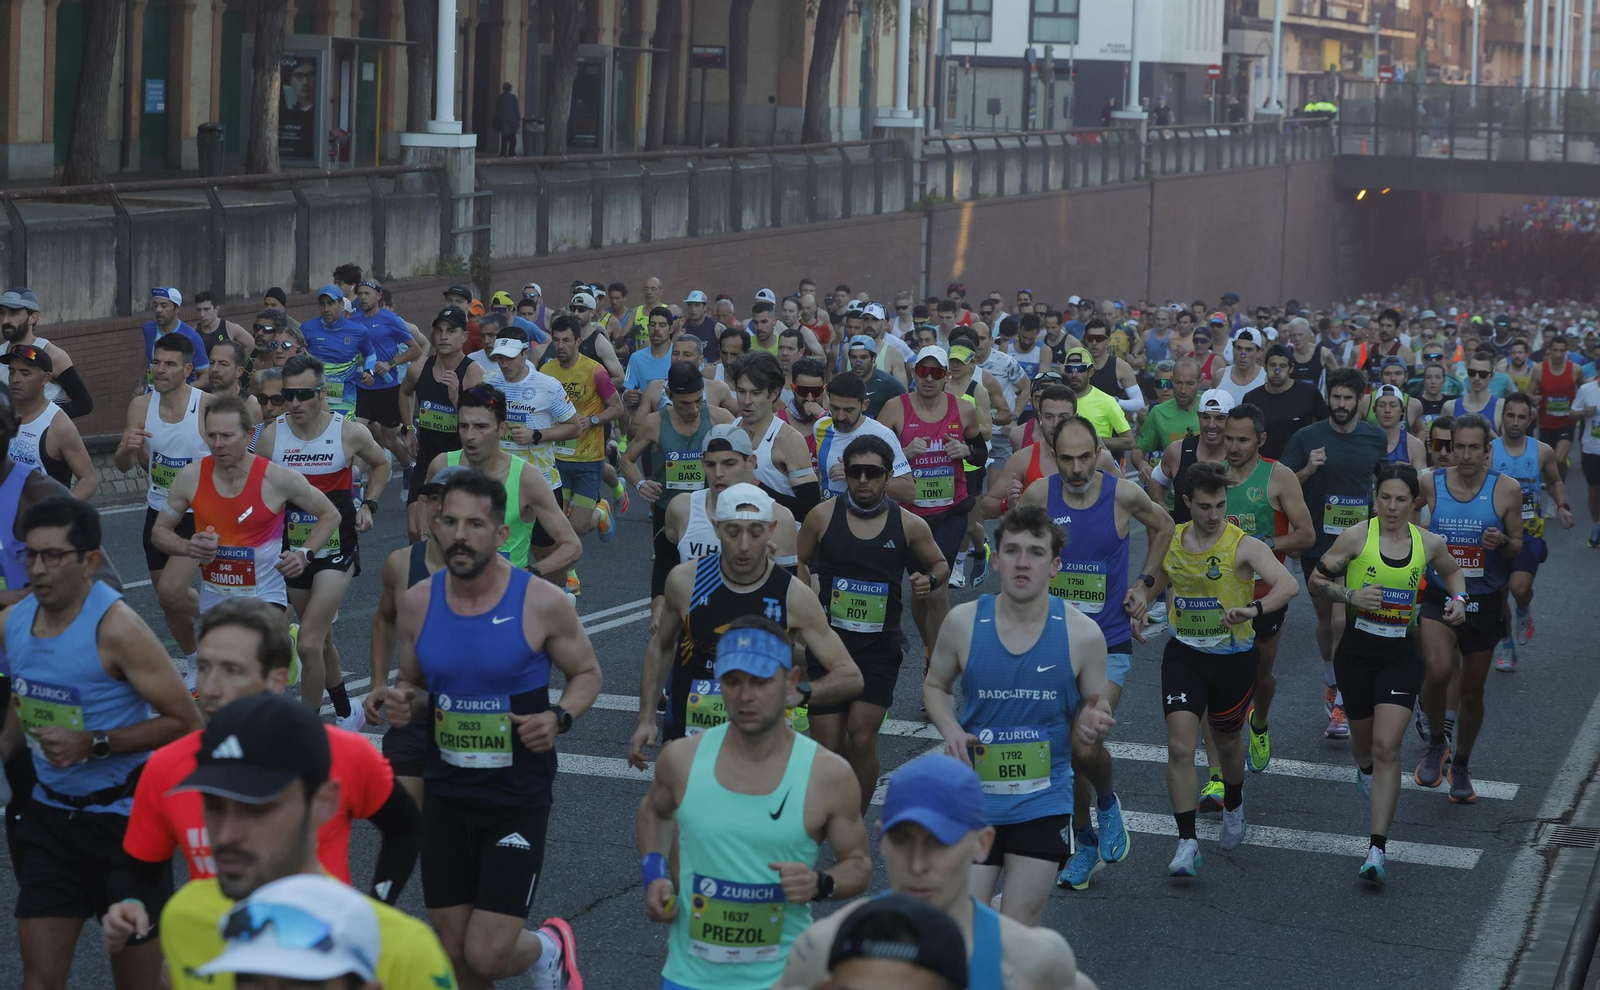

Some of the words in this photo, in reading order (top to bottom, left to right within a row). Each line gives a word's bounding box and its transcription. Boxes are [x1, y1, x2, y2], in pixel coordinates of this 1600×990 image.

[433, 403, 454, 413] ZURICH
[419, 420, 432, 428] LUIS
[432, 423, 457, 432] ROLDAN
[163, 458, 187, 467] ZURICH
[282, 453, 334, 462] HARMAN
[915, 457, 929, 465] LOS
[930, 456, 951, 464] LUNES
[678, 472, 701, 481] BAKS
[924, 468, 949, 476] ZURICH
[921, 488, 943, 498] TONY
[302, 513, 318, 522] ZUR
[1332, 516, 1359, 526] ENEKO
[1438, 517, 1483, 526] MEMORIAL
[1450, 536, 1478, 544] ZURICH
[216, 549, 248, 558] ZURICH
[219, 563, 232, 572] 848
[1066, 562, 1099, 572] ZURICH
[210, 571, 244, 585] SIMON
[1066, 578, 1085, 586] 1750
[850, 583, 882, 594] ZURICH
[1382, 590, 1410, 600] ZURICH
[850, 598, 867, 607] 1706
[1188, 600, 1219, 608] ZURICH
[846, 607, 868, 620] ROY
[1364, 610, 1403, 625] BRENDA
[1190, 615, 1206, 623] 2511
[1176, 627, 1196, 635] PEDRO
[1197, 627, 1229, 636] ALFONSO
[31, 685, 71, 701] ZURICH
[978, 688, 1041, 700] RADCLIFFE
[1041, 689, 1058, 700] RC
[455, 699, 501, 711] ZURICH
[457, 720, 481, 731] 2633
[439, 731, 505, 749] CRISTIAN
[998, 730, 1040, 741] ZURICH
[1000, 750, 1023, 761] 1792
[998, 763, 1027, 778] BEN
[721, 885, 775, 900] ZURICH
[722, 910, 750, 923] 1637
[702, 922, 767, 944] PREZOL
